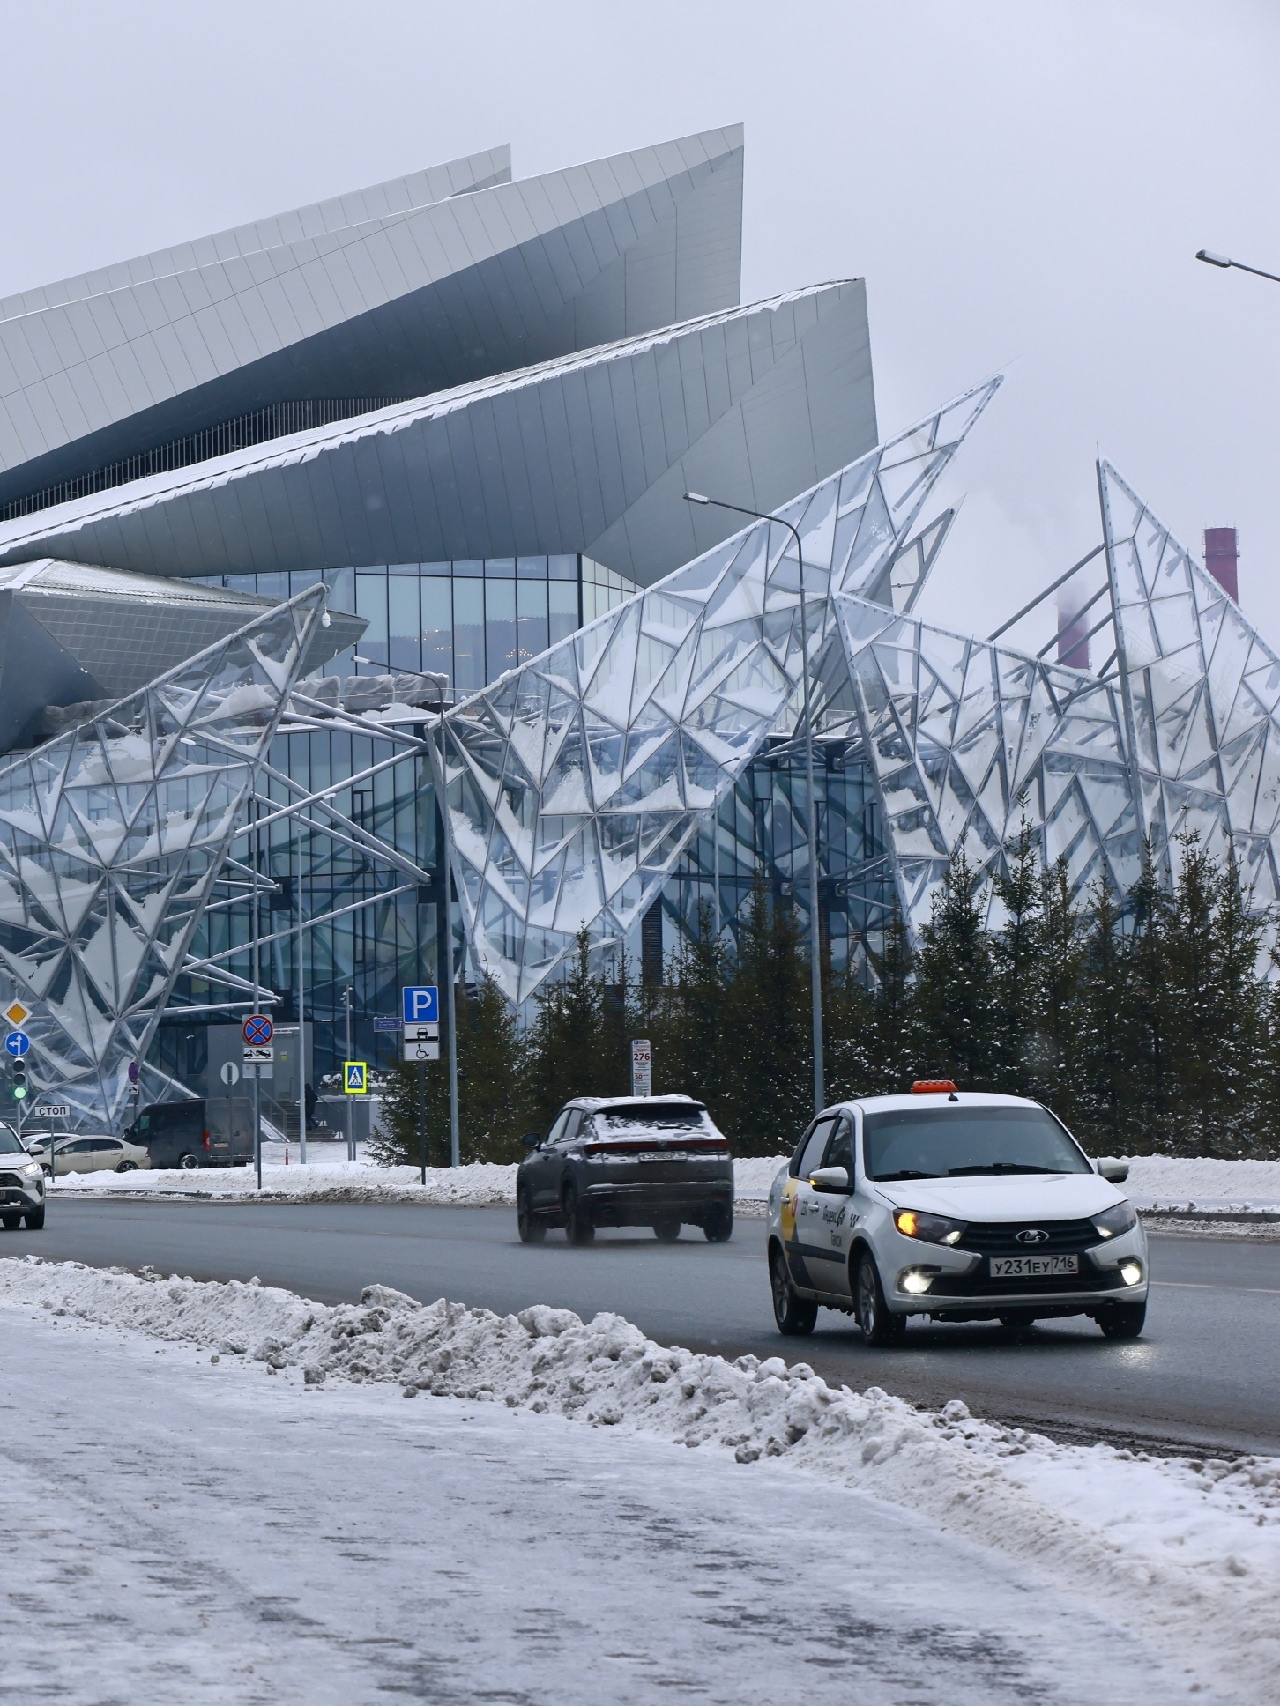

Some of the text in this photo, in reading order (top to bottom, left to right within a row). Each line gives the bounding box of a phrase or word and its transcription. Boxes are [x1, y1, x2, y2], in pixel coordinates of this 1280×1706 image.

[413, 990, 432, 1019] P
[634, 1052, 650, 1061] 276
[39, 1107, 66, 1116] СТОП
[994, 1256, 1075, 1275] У231ЕУ 716
